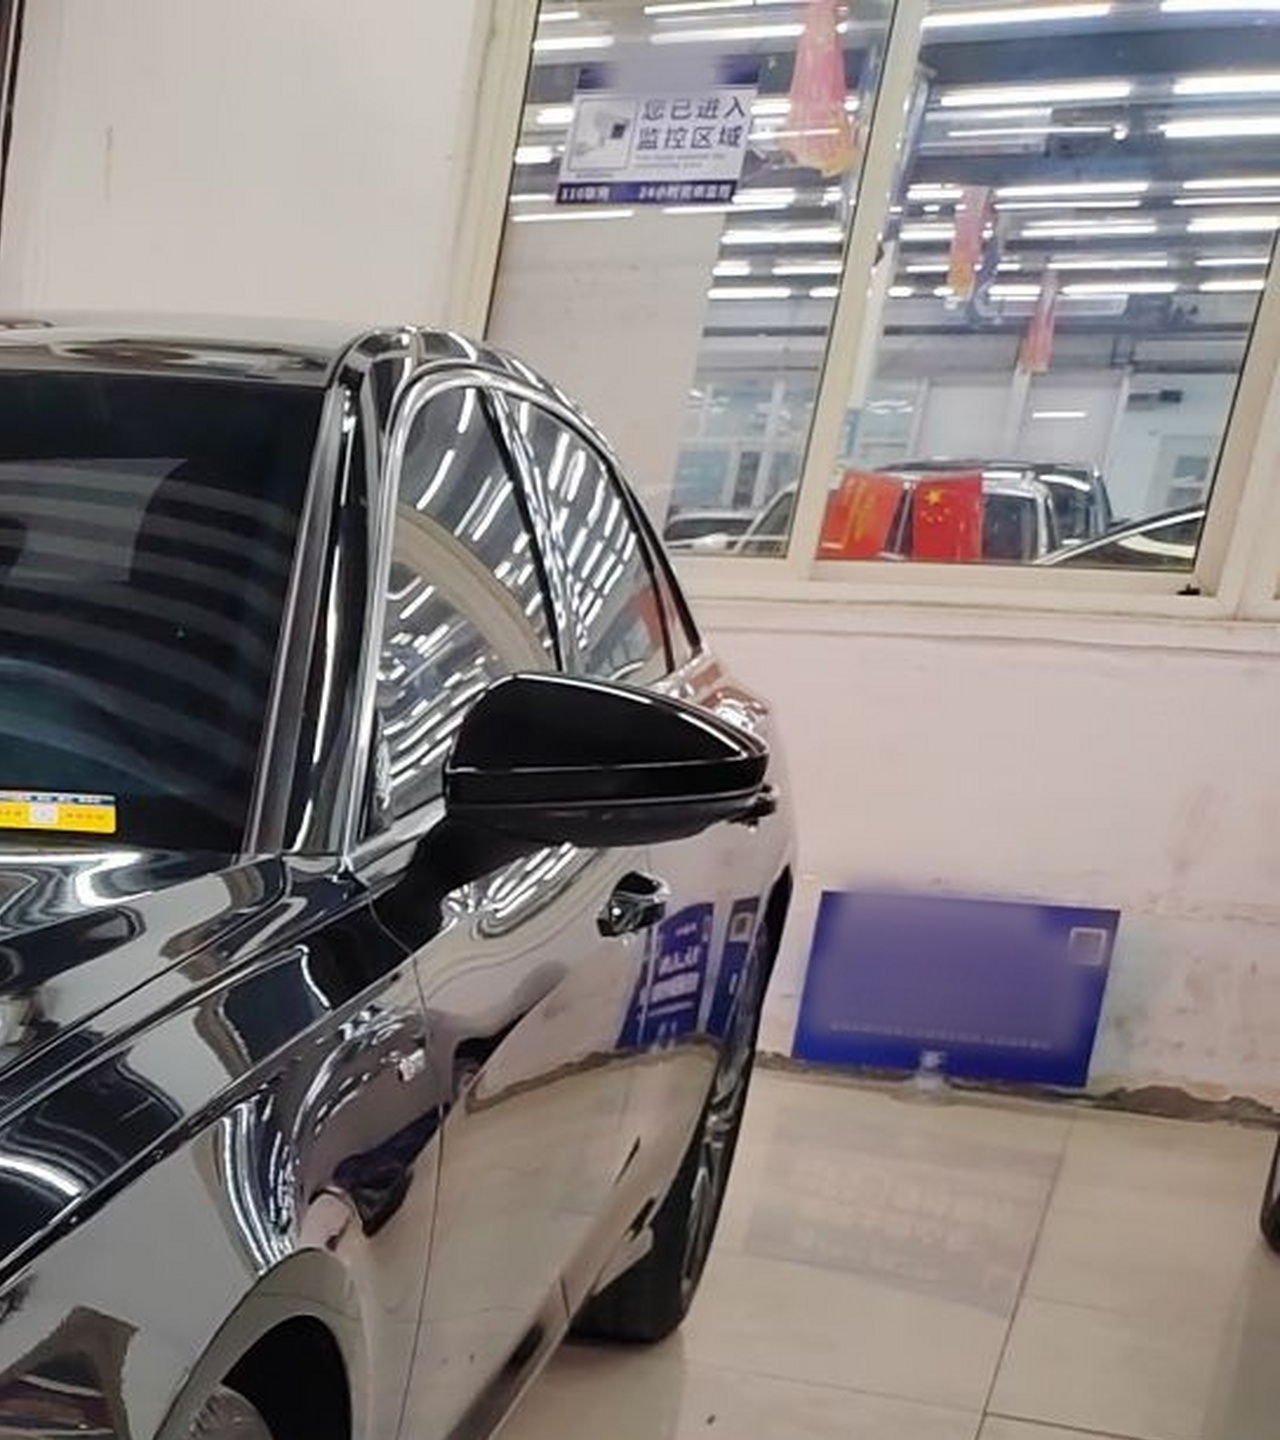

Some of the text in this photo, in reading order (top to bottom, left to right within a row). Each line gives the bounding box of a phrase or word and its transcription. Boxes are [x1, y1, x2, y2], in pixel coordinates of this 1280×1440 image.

[641, 97, 746, 121] 您已进入
[638, 125, 743, 150] 监控区域
